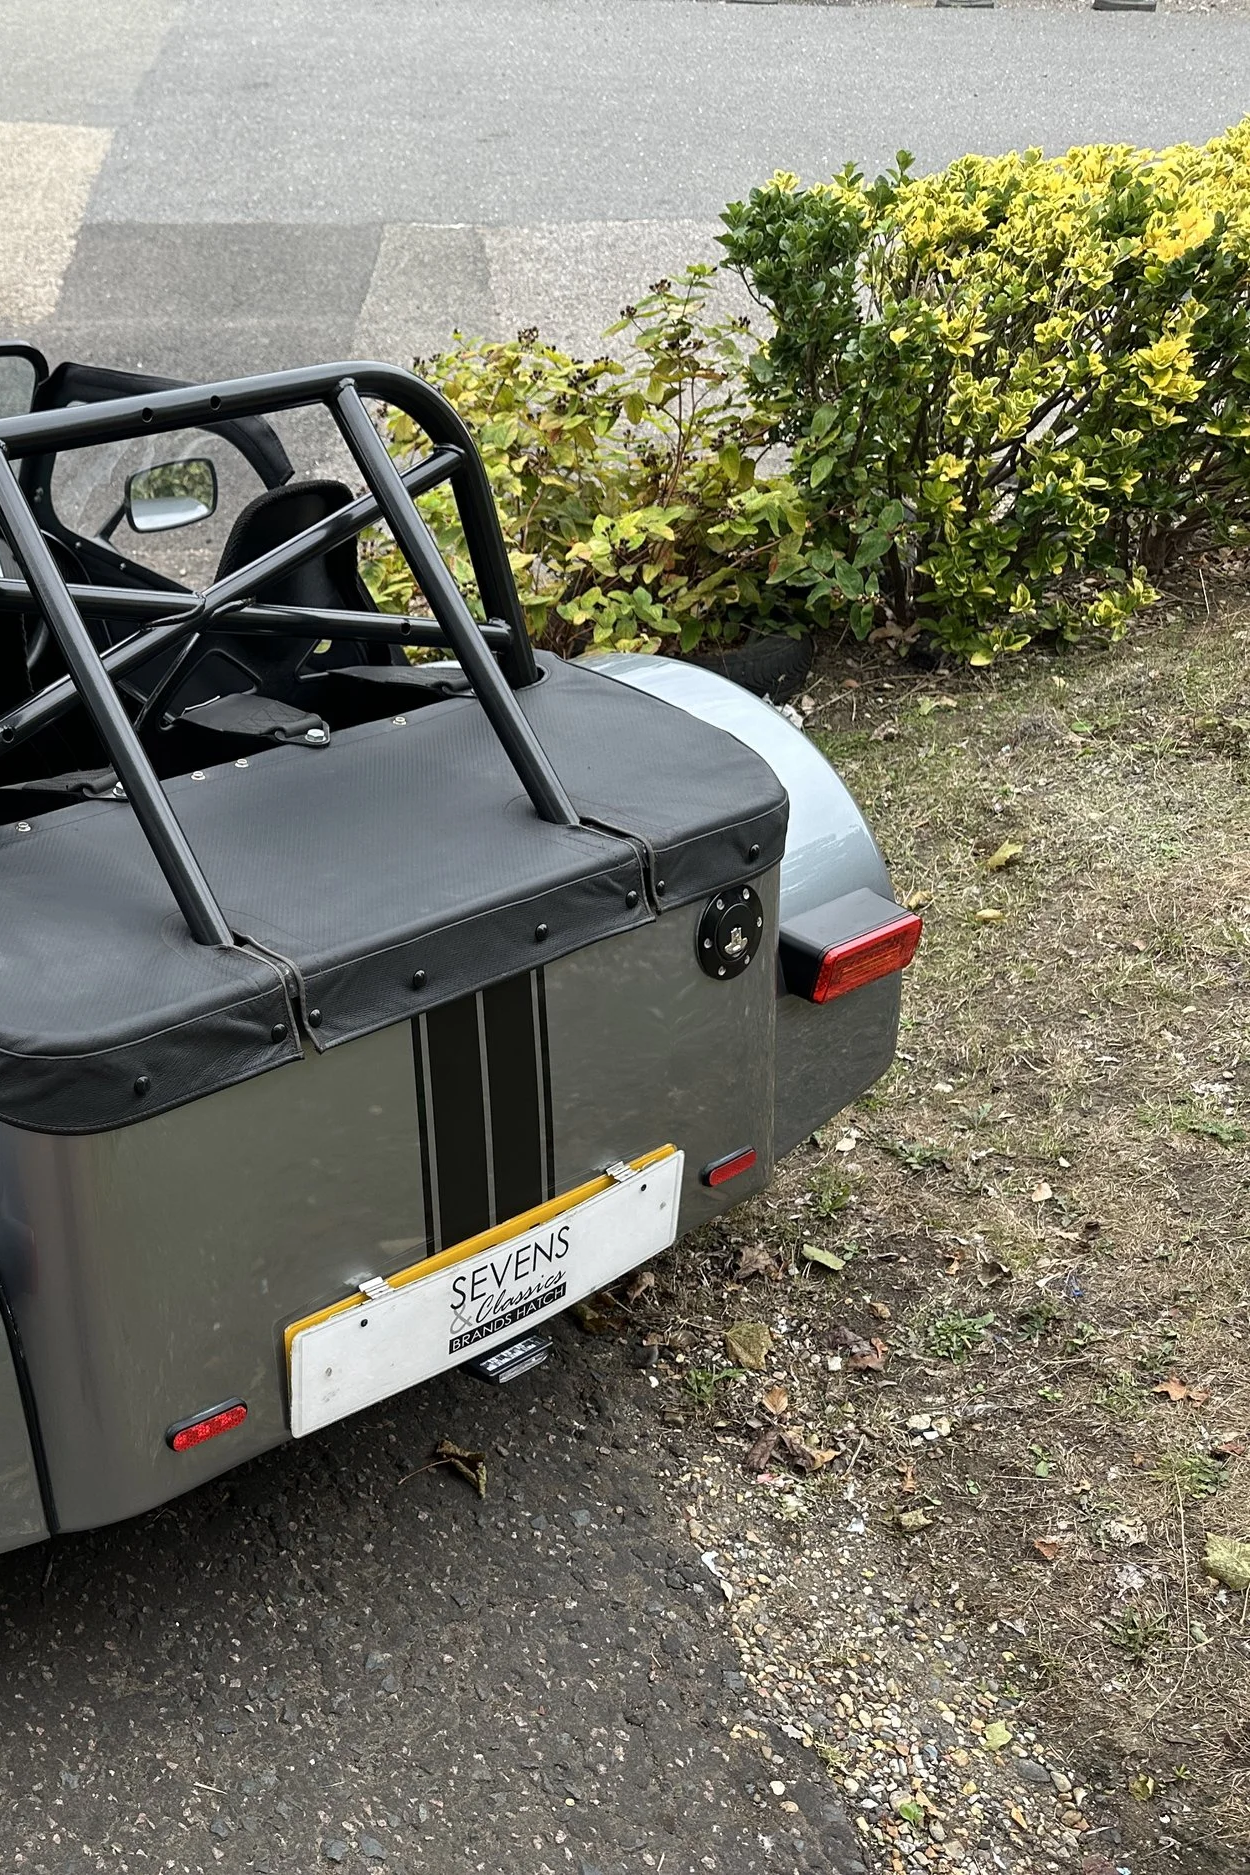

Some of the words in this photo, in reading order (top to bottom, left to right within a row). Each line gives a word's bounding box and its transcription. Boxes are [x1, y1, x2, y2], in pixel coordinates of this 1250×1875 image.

[450, 1225, 570, 1310] SEVENS
[449, 1302, 473, 1335] &
[475, 1270, 567, 1324] Classics
[452, 1314, 512, 1352] BRANDS
[516, 1285, 564, 1320] HATCH
